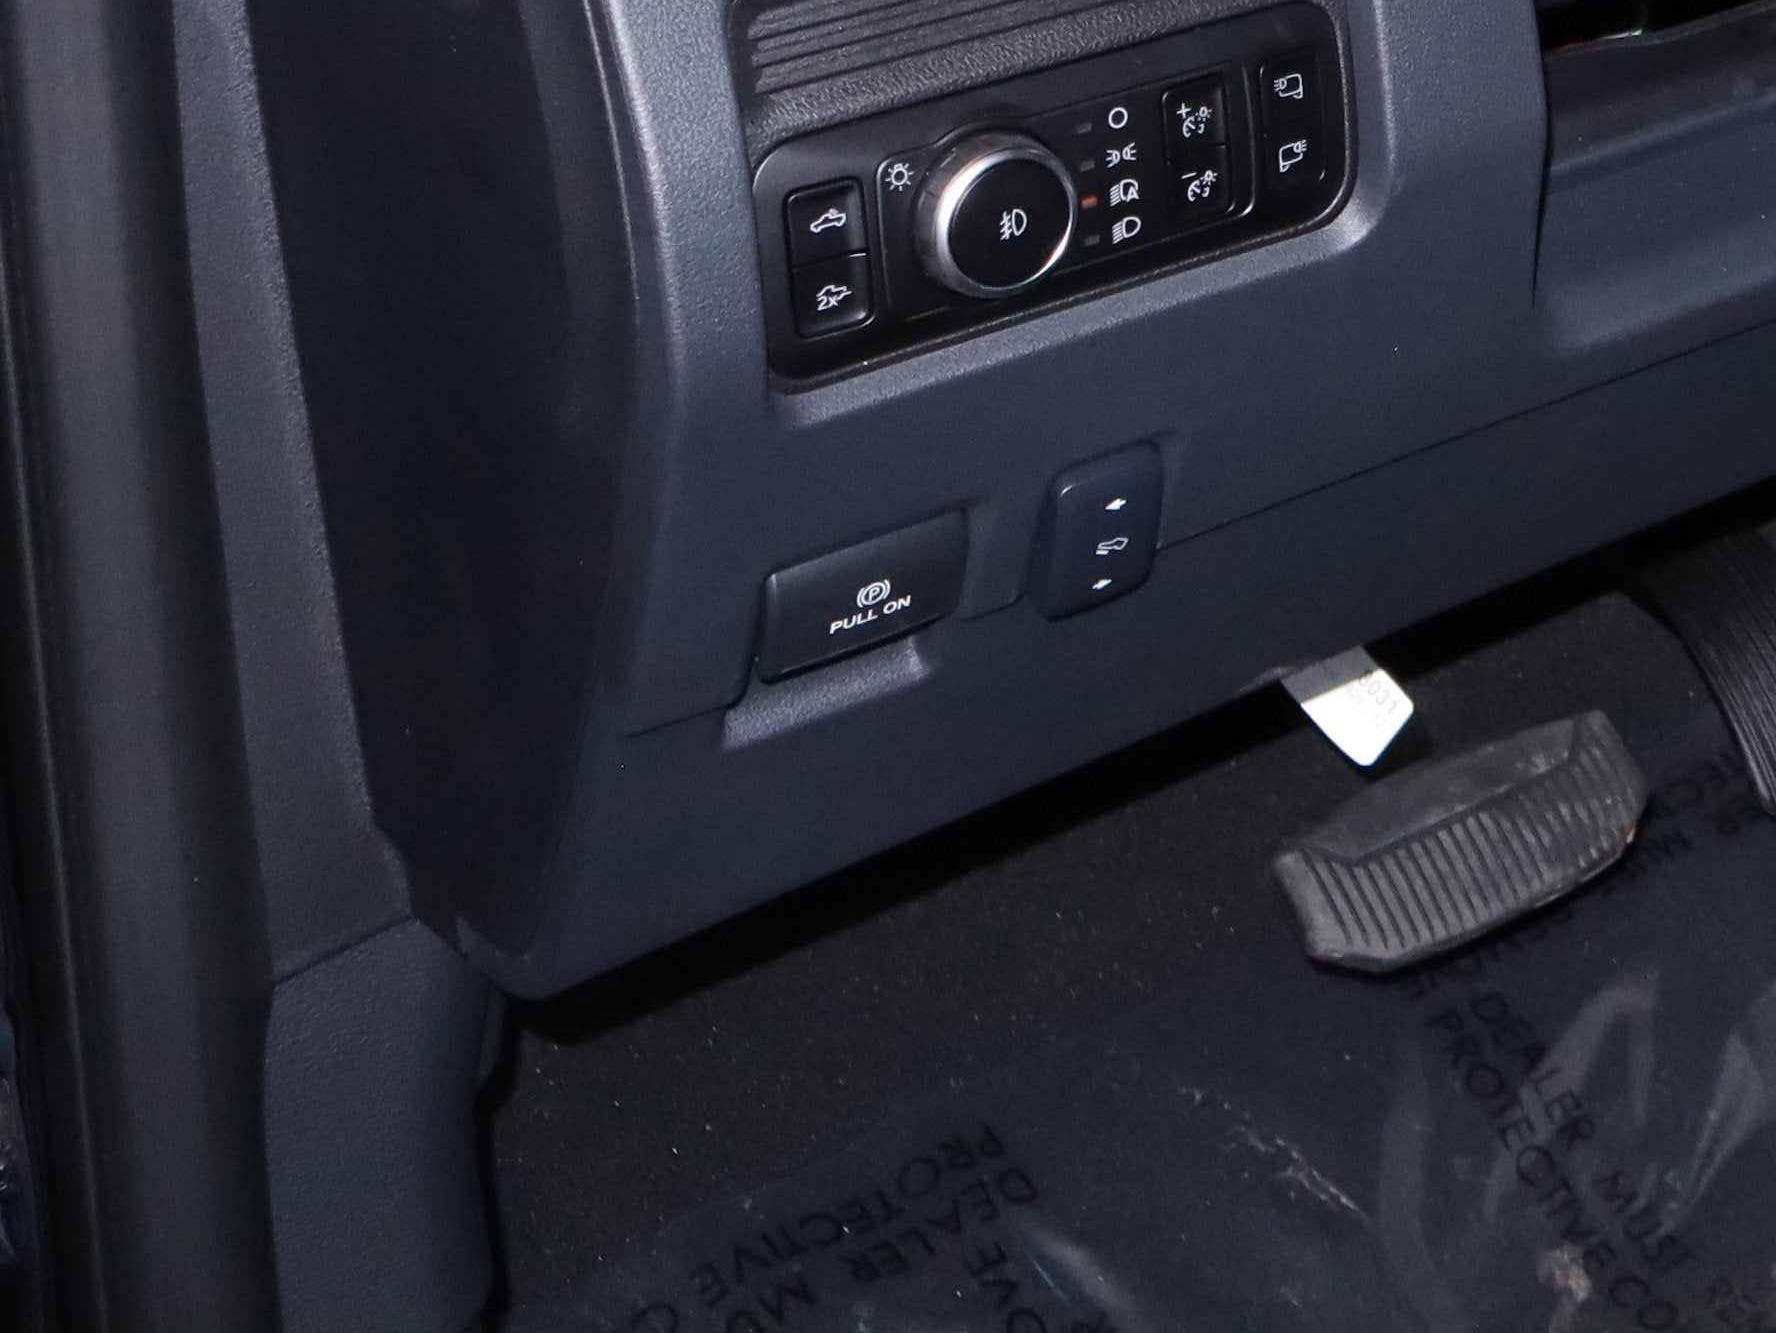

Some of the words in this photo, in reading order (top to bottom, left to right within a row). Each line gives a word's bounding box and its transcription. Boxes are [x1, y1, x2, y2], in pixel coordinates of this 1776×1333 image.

[829, 608, 878, 635] PULL
[883, 594, 912, 615] ON
[689, 1122, 1005, 1307] PROTECTIVE
[843, 1168, 1038, 1283] DEALER
